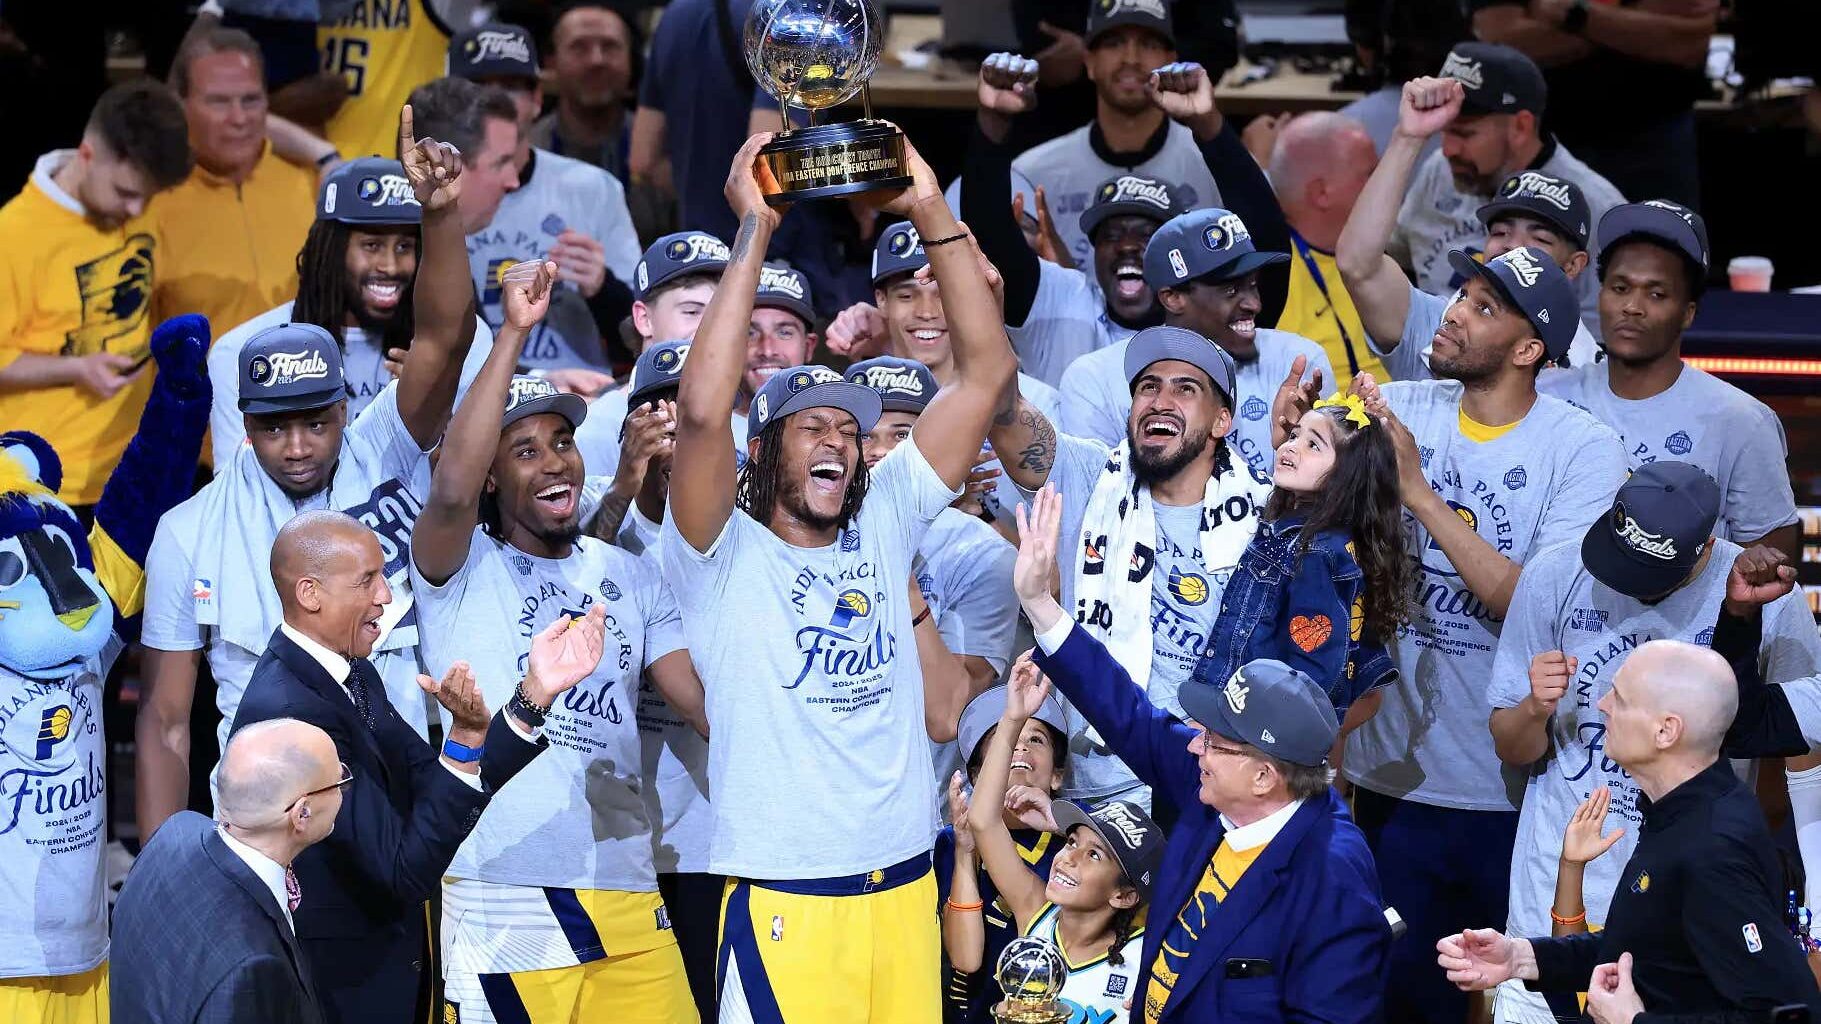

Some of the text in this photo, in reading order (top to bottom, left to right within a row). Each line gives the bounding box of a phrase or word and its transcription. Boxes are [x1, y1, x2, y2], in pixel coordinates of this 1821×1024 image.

[795, 167, 824, 181] EASTERN
[826, 161, 868, 176] CONFERENCE
[1112, 176, 1170, 209] Finals
[1507, 172, 1570, 210] Finals
[263, 350, 328, 388] Finals
[867, 366, 923, 396] Finals
[1471, 480, 1513, 559] PACER
[1616, 516, 1678, 560] Finals
[579, 593, 632, 671] PCERS
[1150, 594, 1203, 656] Fin
[1430, 627, 1449, 636] NBA
[1444, 620, 1470, 630] 2025
[851, 686, 869, 694] NBA
[852, 687, 892, 703] CONFEREN
[0, 751, 103, 834] Finals
[66, 825, 82, 835] NBA
